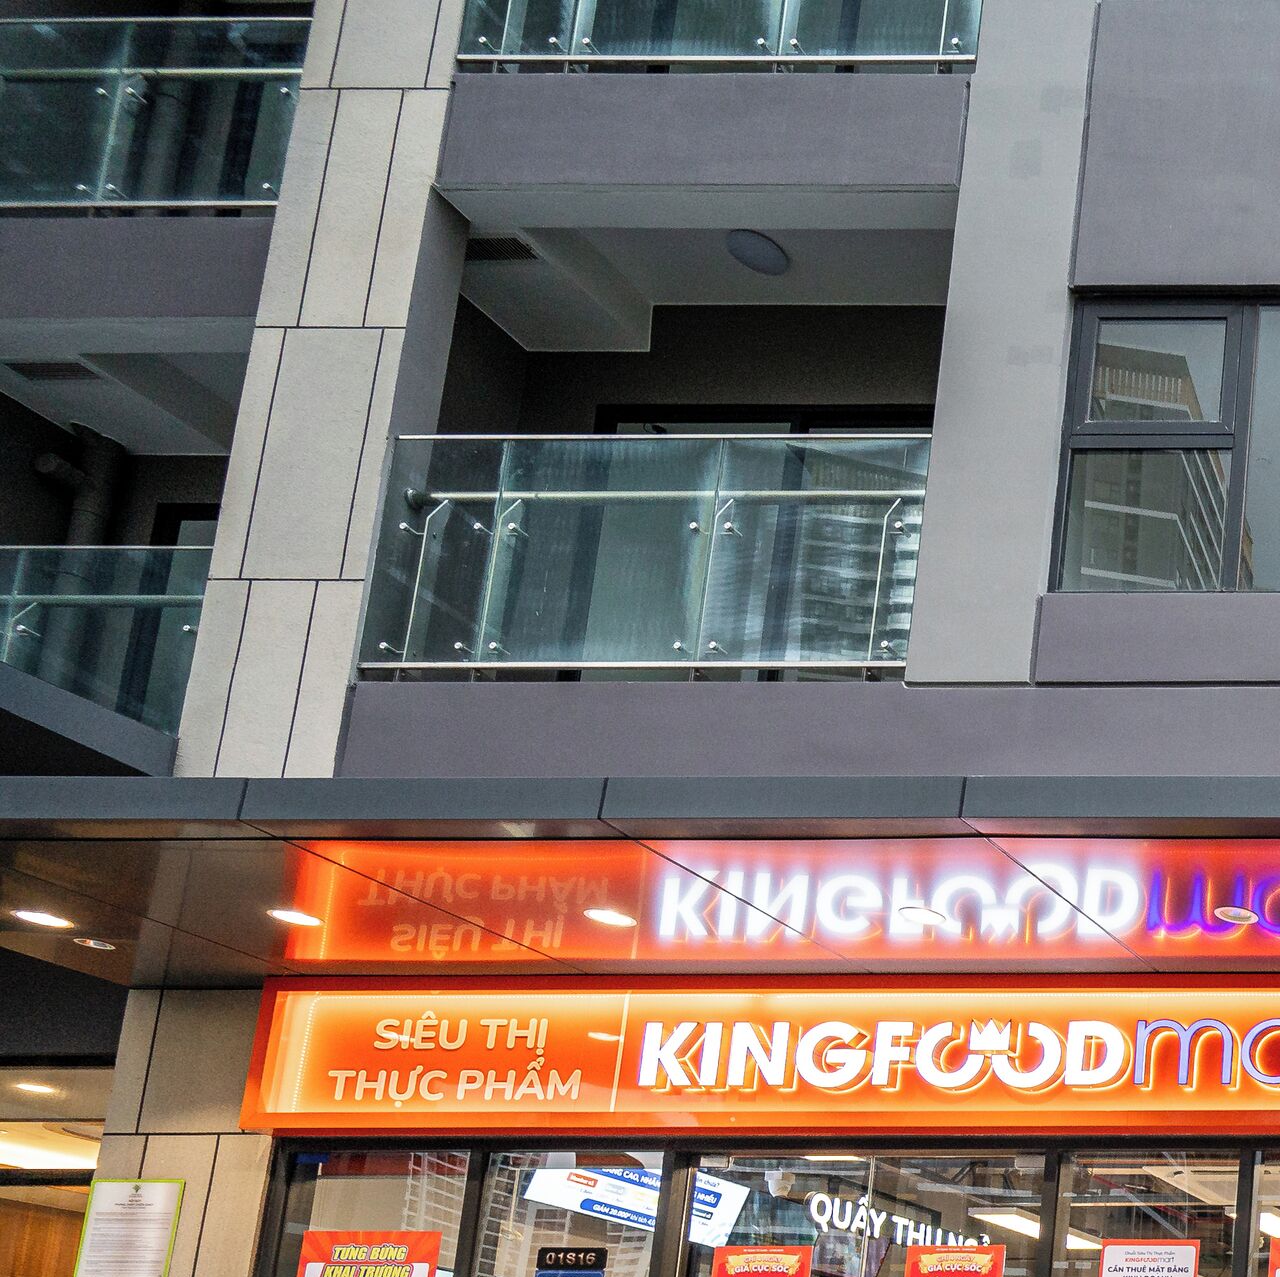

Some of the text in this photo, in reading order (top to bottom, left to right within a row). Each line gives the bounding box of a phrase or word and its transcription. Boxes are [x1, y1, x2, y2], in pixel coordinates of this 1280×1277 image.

[374, 1010, 548, 1056] SIÊU THỊ
[328, 1057, 582, 1108] THỰC PHẨM
[891, 1215, 943, 1246] THU
[1108, 1265, 1189, 1275] CẦN THUÊ MẶT BẰNG
